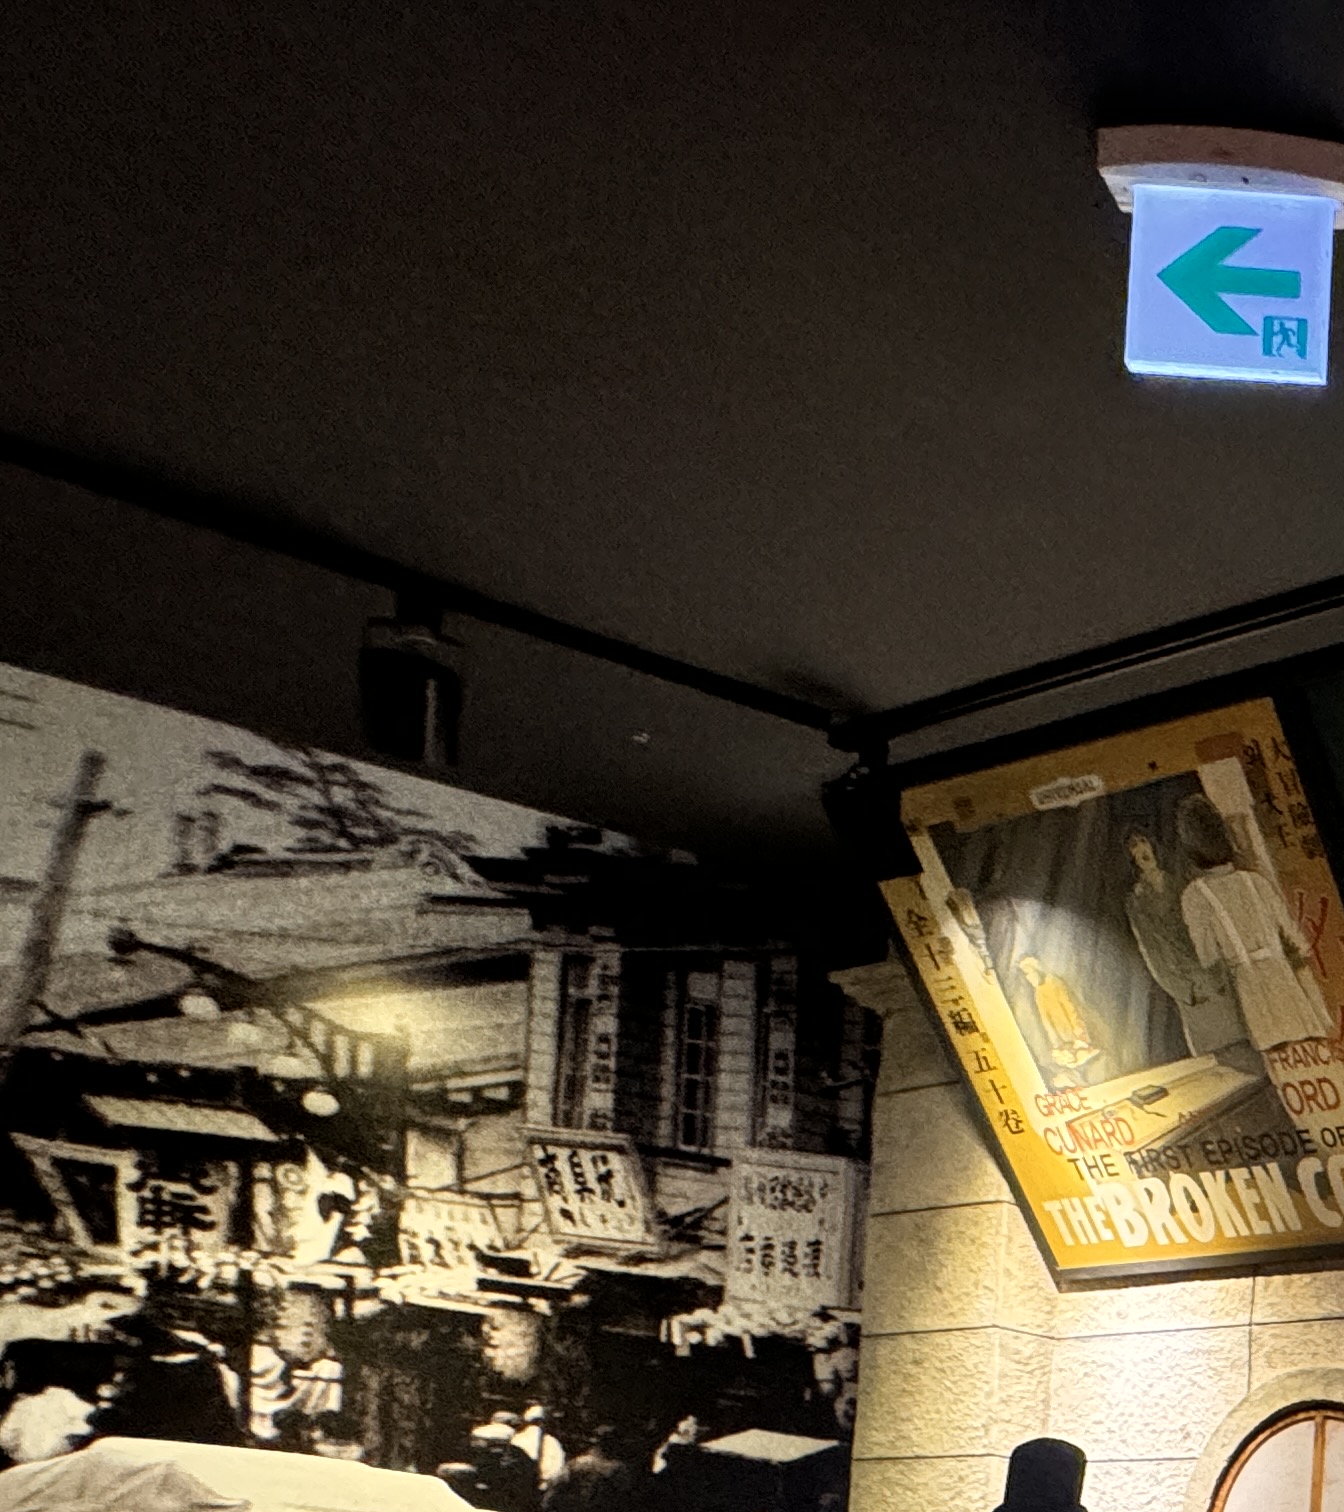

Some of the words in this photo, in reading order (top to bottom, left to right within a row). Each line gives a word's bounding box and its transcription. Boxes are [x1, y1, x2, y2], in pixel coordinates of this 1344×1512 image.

[1035, 1088, 1092, 1117] GRACE
[1043, 1116, 1135, 1156] CUNARD
[1067, 1153, 1120, 1181] THE
[1124, 1144, 1198, 1176] FIRST
[1200, 1127, 1318, 1168] EPISODE
[1044, 1196, 1115, 1248] THE
[1094, 1162, 1301, 1249] BROKEN
